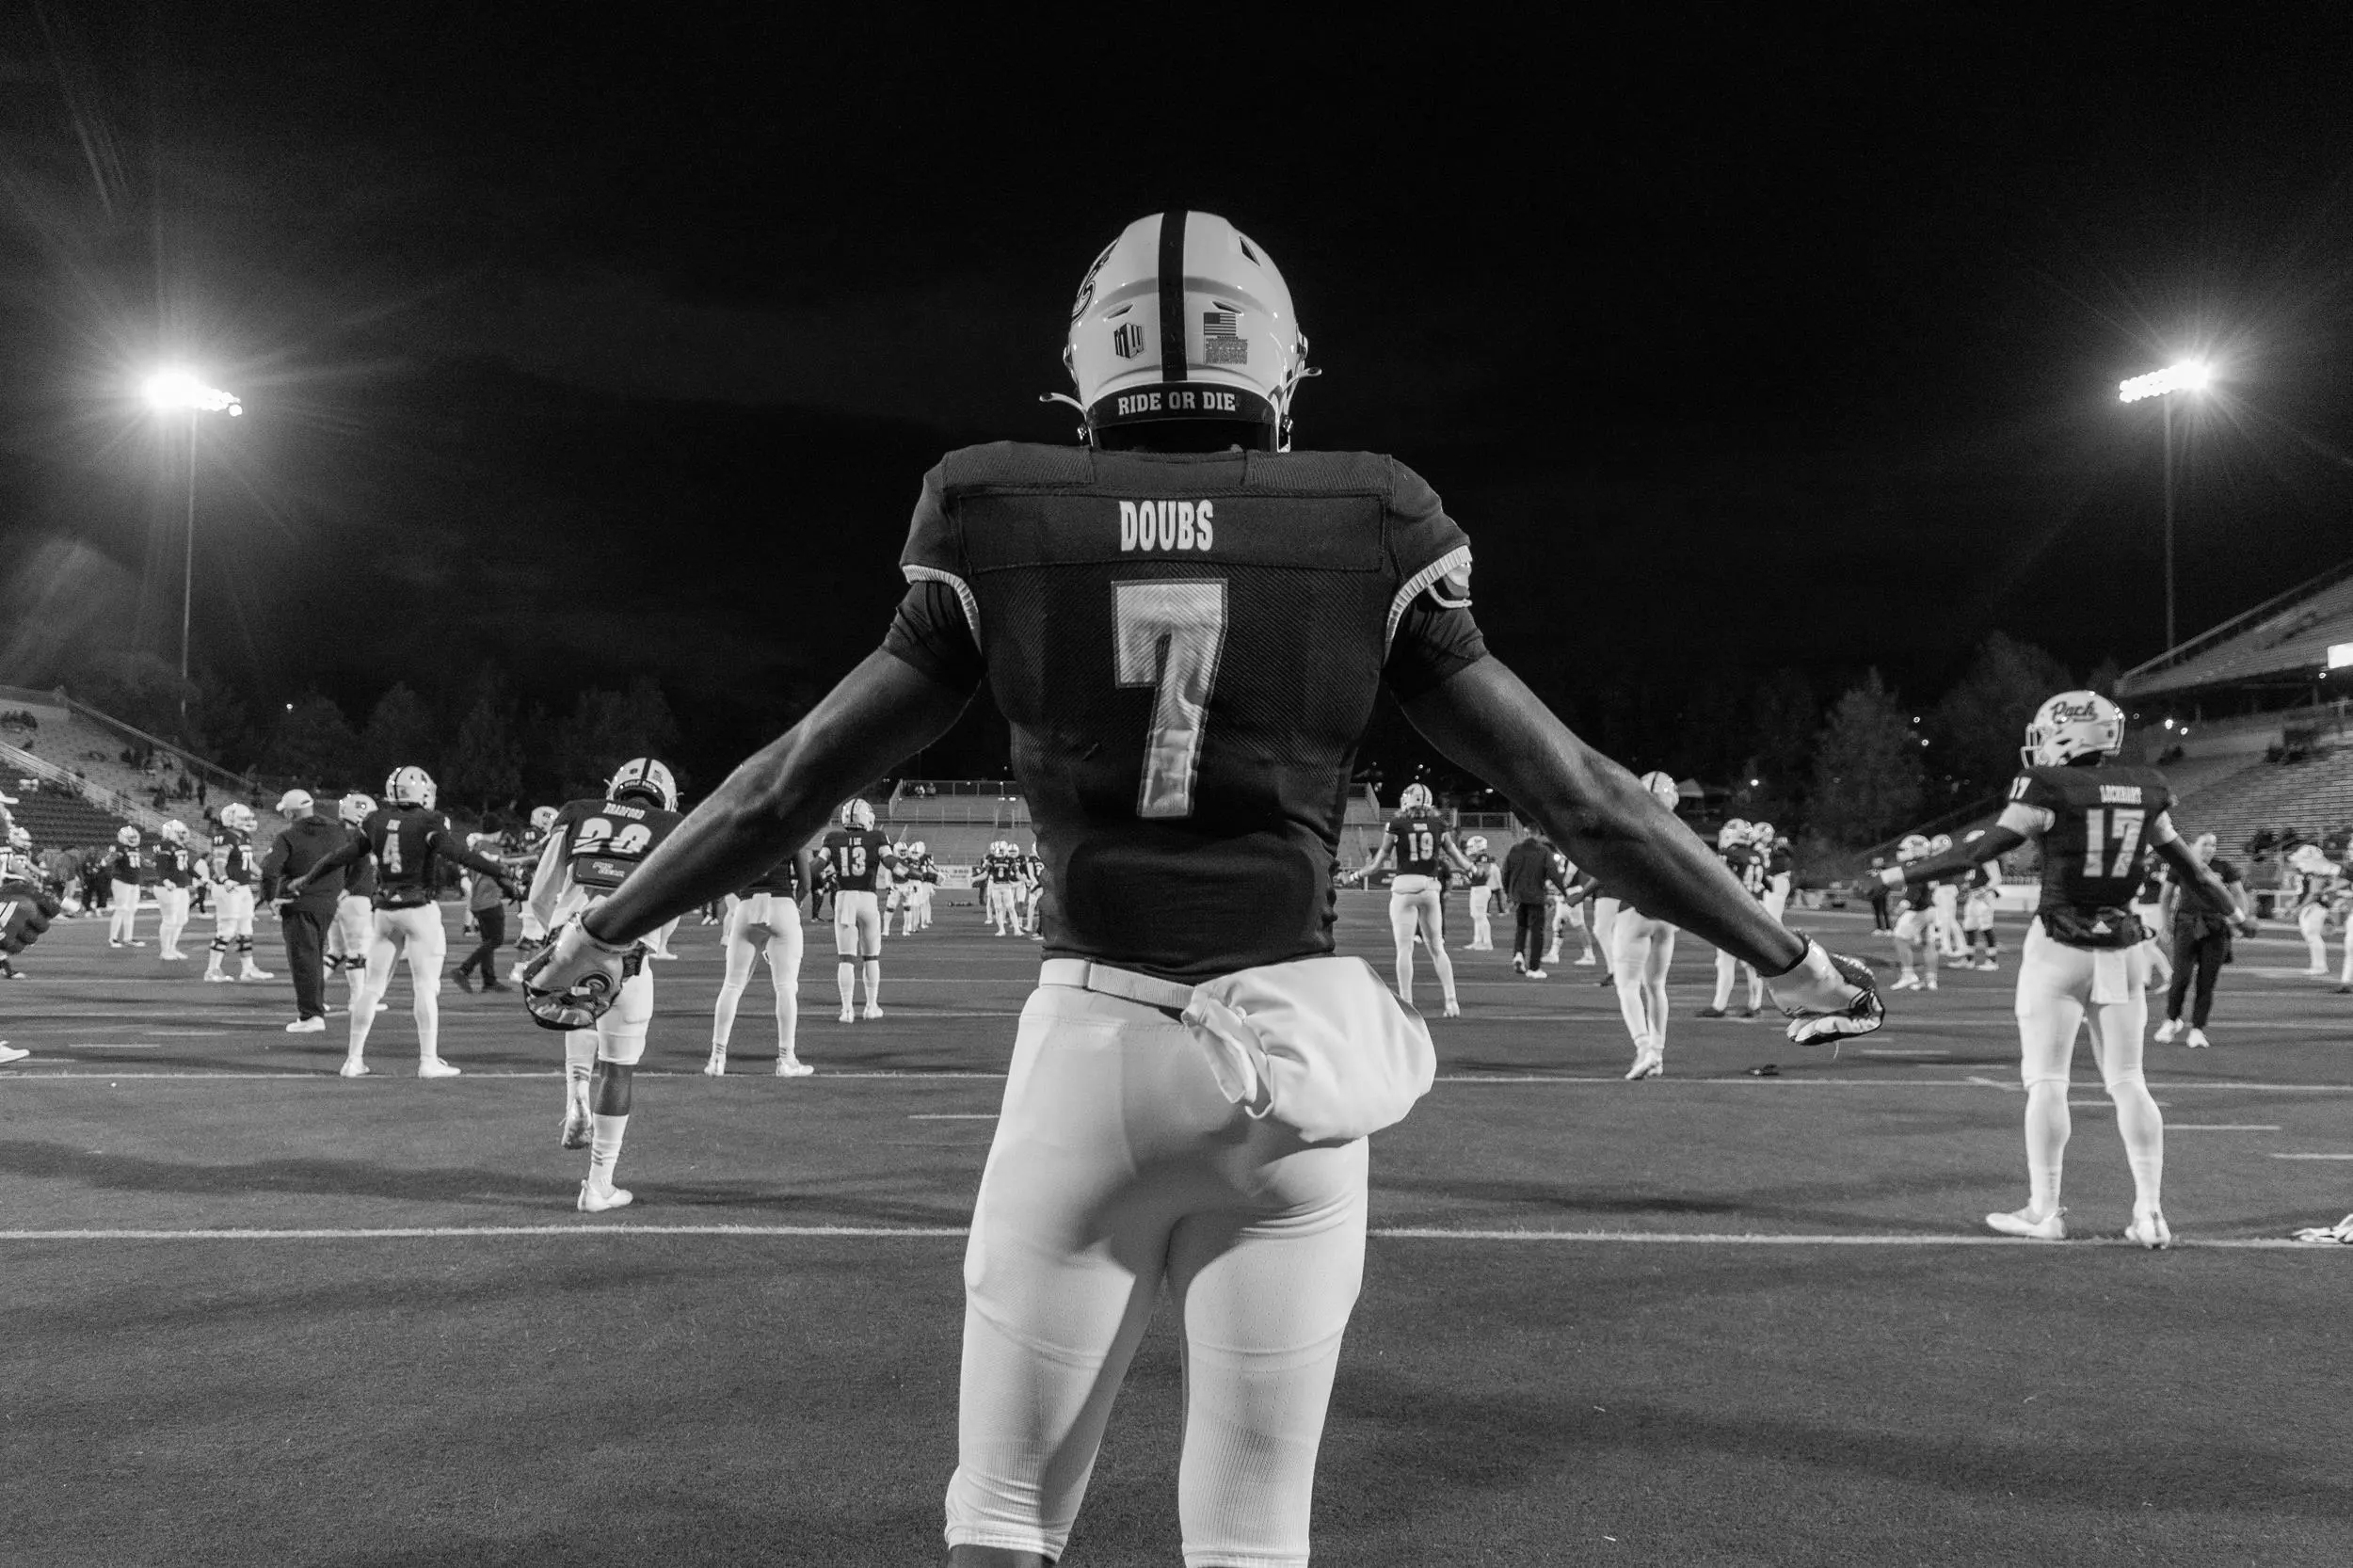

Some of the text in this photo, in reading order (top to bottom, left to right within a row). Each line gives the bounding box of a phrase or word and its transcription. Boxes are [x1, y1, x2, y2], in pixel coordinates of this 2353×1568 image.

[1117, 391, 1236, 416] RIDE OR DIE
[1119, 499, 1214, 552] DOUBS
[1111, 578, 1228, 820] 7
[2050, 699, 2099, 724] Pack
[382, 819, 403, 873] 4
[840, 846, 867, 876] 13
[1408, 832, 1433, 861] 19
[2083, 808, 2146, 878] 17
